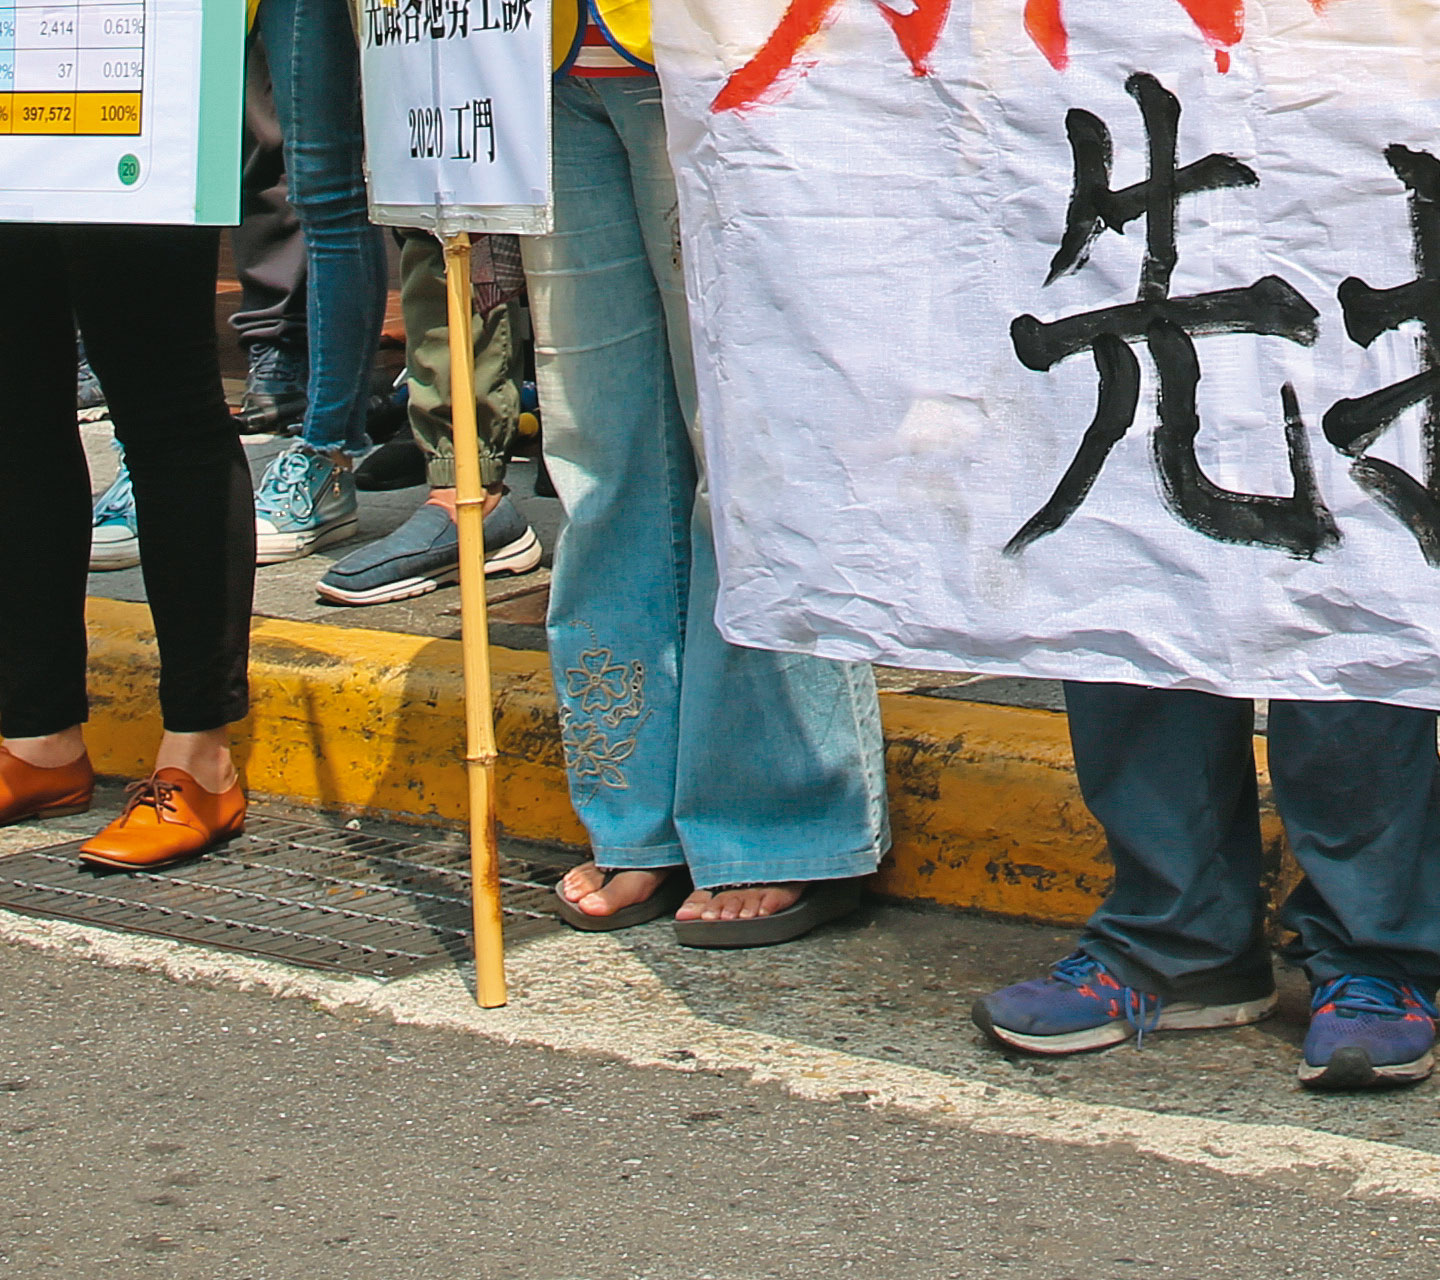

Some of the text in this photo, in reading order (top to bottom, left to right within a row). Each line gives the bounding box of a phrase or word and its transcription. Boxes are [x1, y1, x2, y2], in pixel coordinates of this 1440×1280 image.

[40, 21, 73, 37] 2,414
[104, 18, 144, 35] 0.61%
[58, 63, 73, 78] 37
[103, 62, 143, 78] 0.01%
[23, 106, 71, 122] 397,572
[100, 105, 137, 121] 100%
[409, 106, 444, 160] 2020
[122, 162, 137, 177] 20
